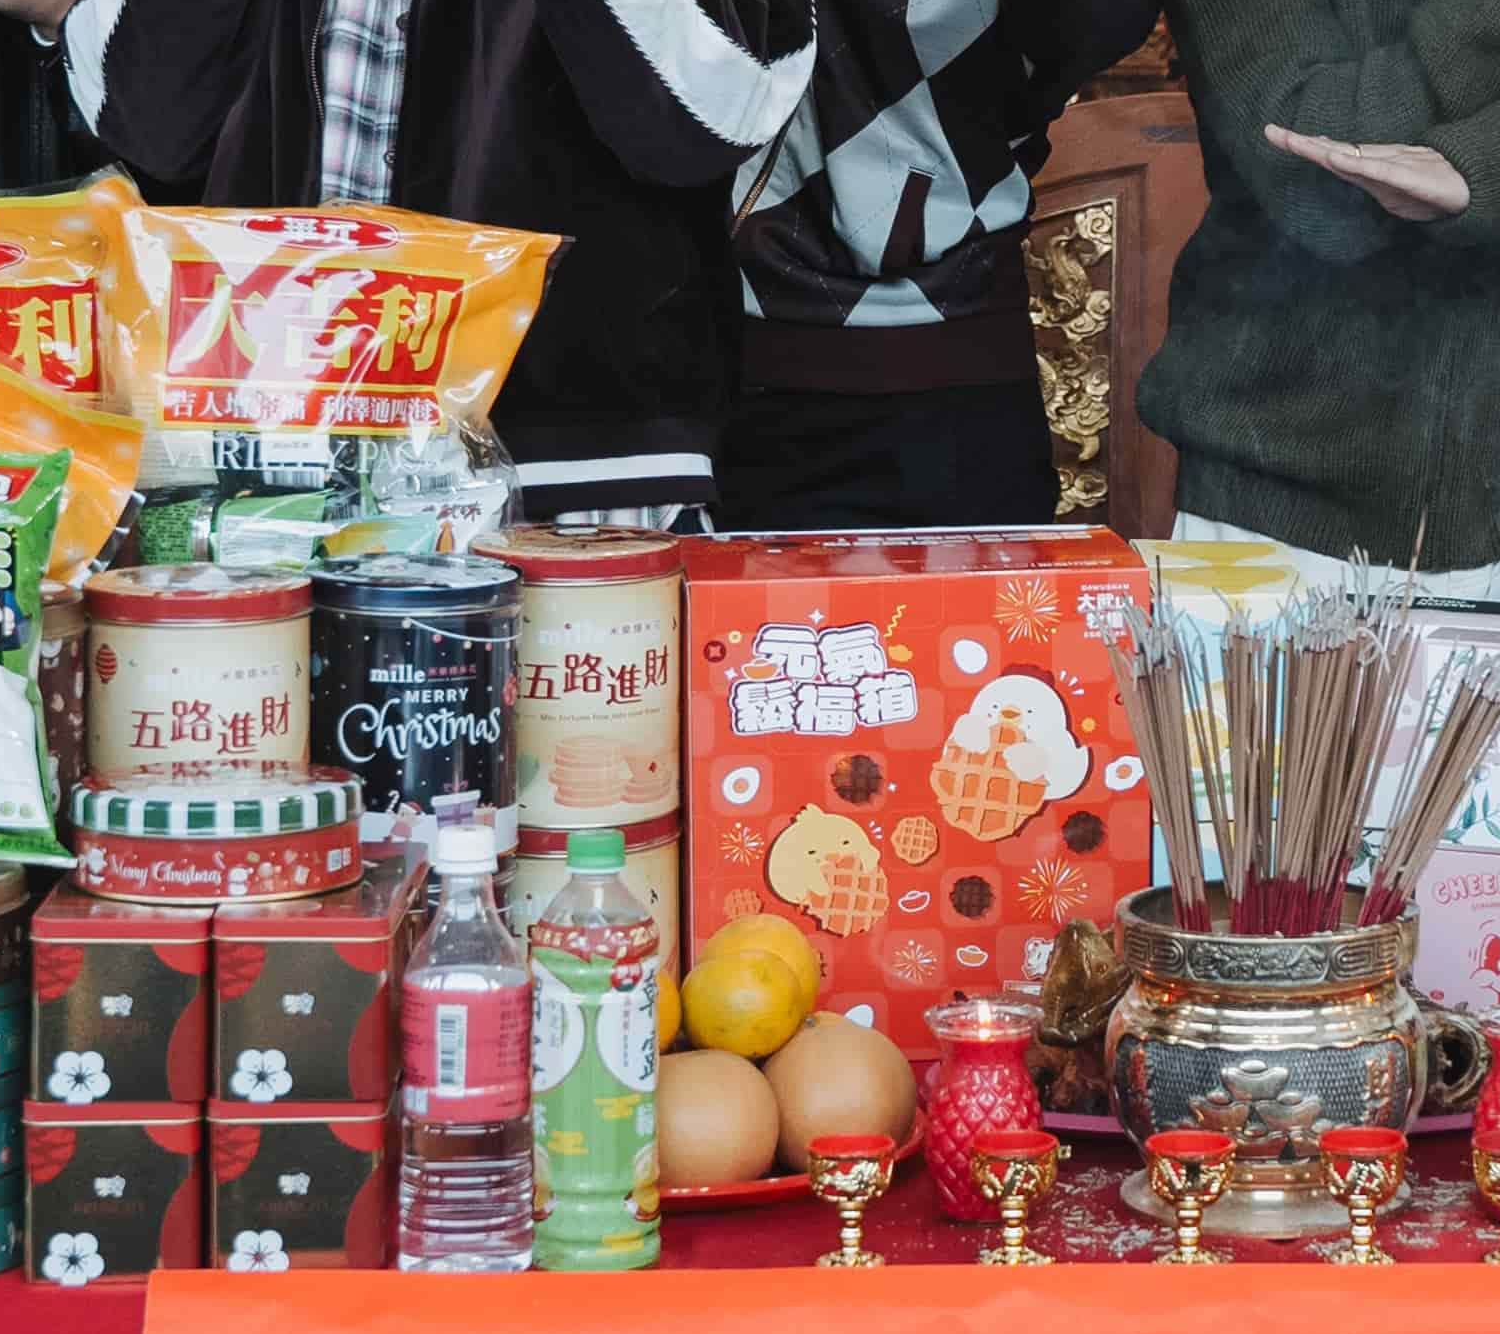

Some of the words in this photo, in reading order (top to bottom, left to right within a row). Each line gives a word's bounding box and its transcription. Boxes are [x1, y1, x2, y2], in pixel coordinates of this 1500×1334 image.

[169, 273, 458, 373] 大吉利
[369, 665, 427, 685] mille
[524, 644, 671, 706] 五路進財
[751, 624, 888, 683] 元氣
[129, 692, 291, 757] 五路進財
[404, 686, 469, 704] MERRY
[729, 672, 918, 735] 鬆福箱
[336, 700, 502, 764] Christmas
[109, 857, 150, 886] Merry
[152, 858, 223, 885] Christmas
